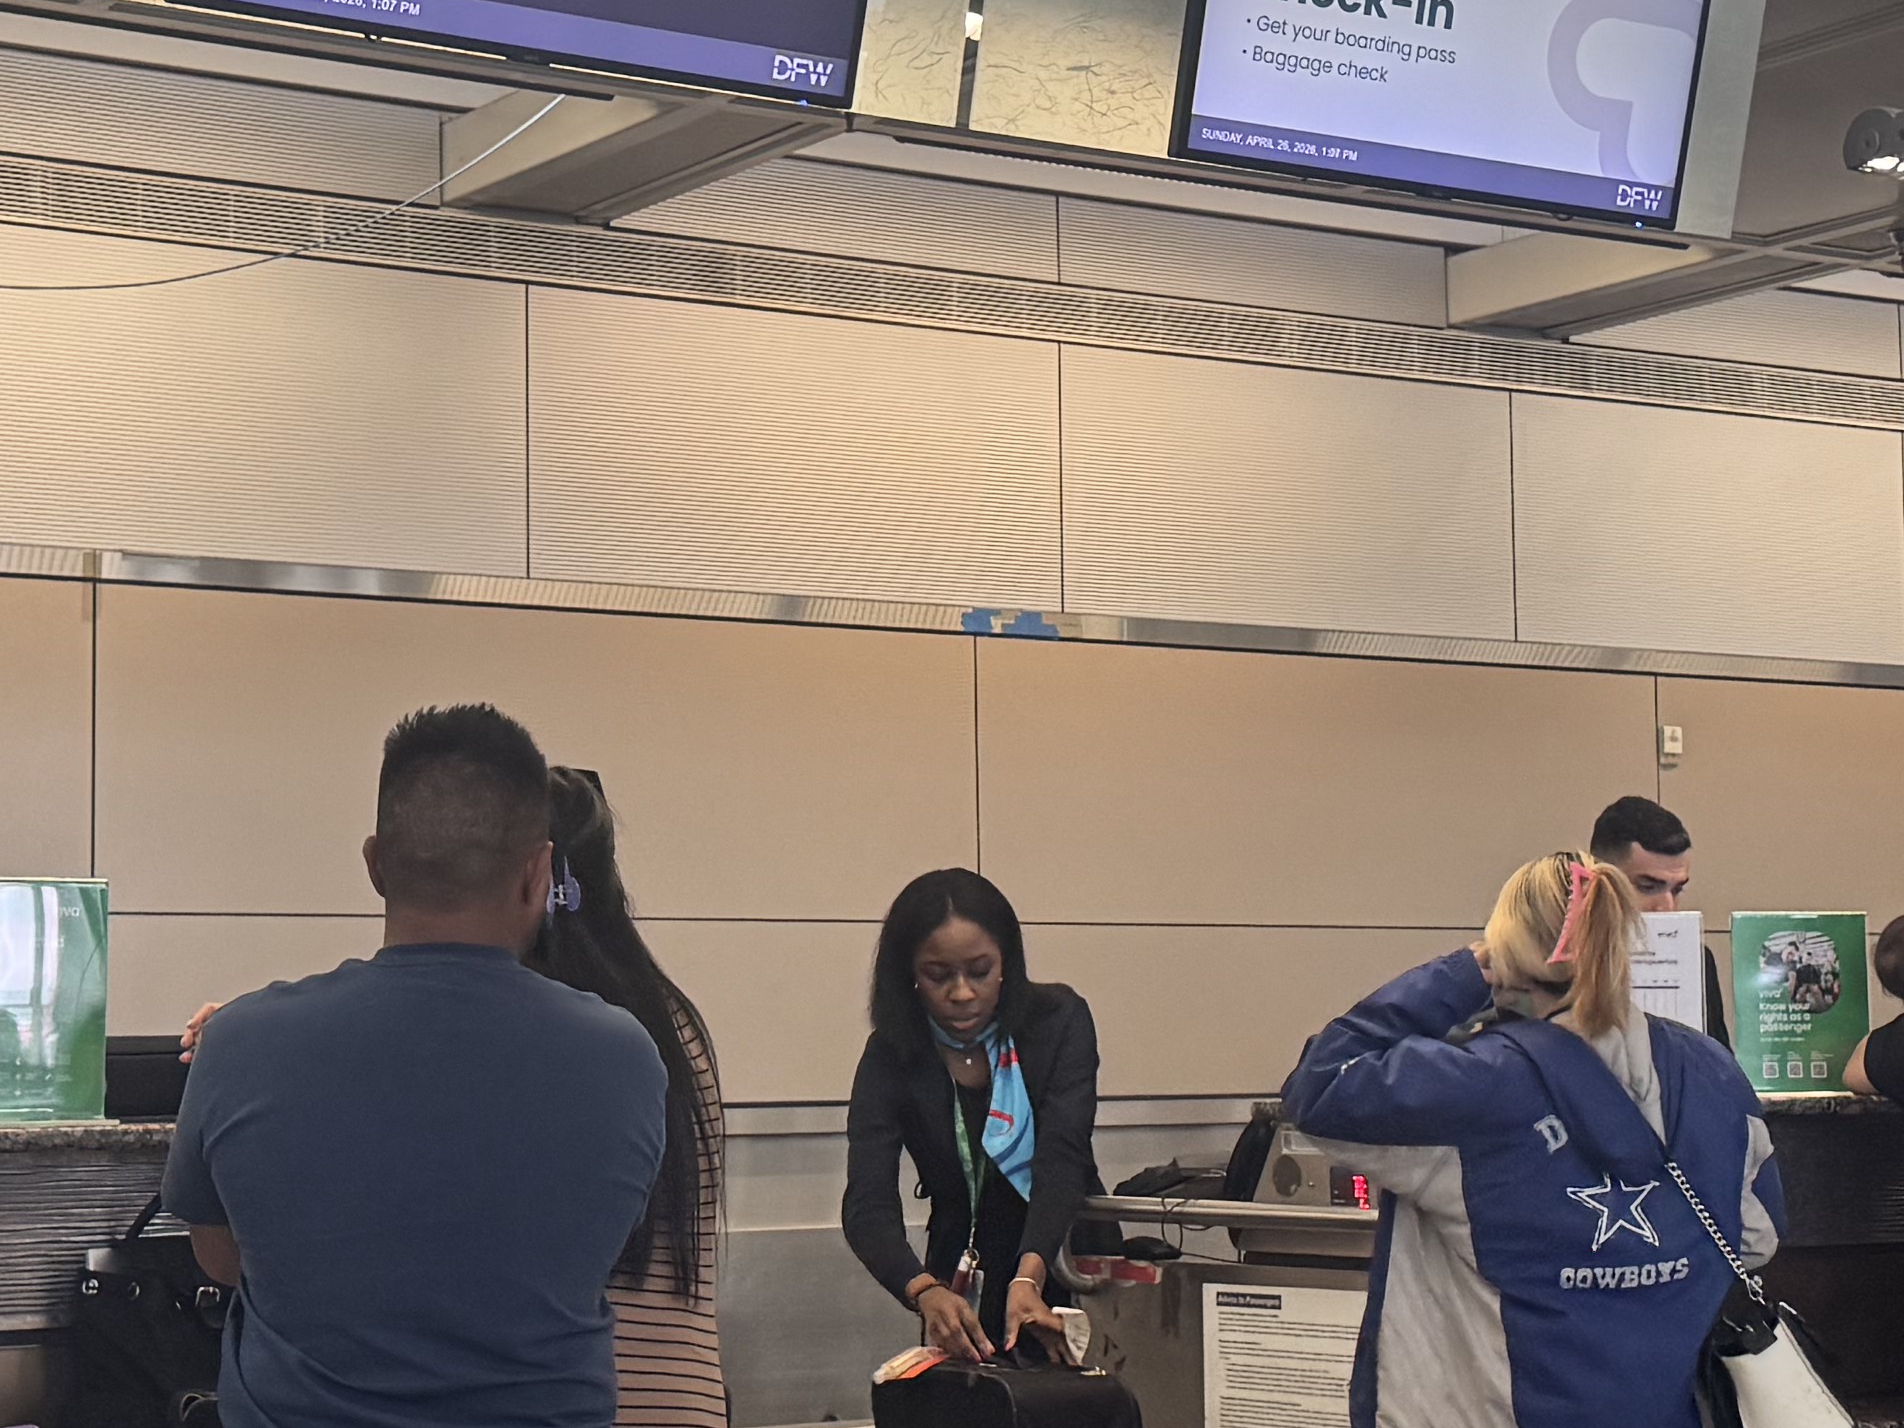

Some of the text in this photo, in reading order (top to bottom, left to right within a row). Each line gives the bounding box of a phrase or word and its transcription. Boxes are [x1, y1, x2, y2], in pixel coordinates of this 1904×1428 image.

[400, 1, 420, 16] PM
[1256, 15, 1456, 64] Get your boarding pass
[772, 54, 834, 87] DFW
[1253, 45, 1388, 83] Baggage check
[1202, 128, 1243, 145] SUNDAY,
[1246, 135, 1274, 149] APRIL
[1342, 150, 1358, 161] PM
[1616, 184, 1662, 211] DFW
[1560, 1257, 1689, 1289] COWBOYS
